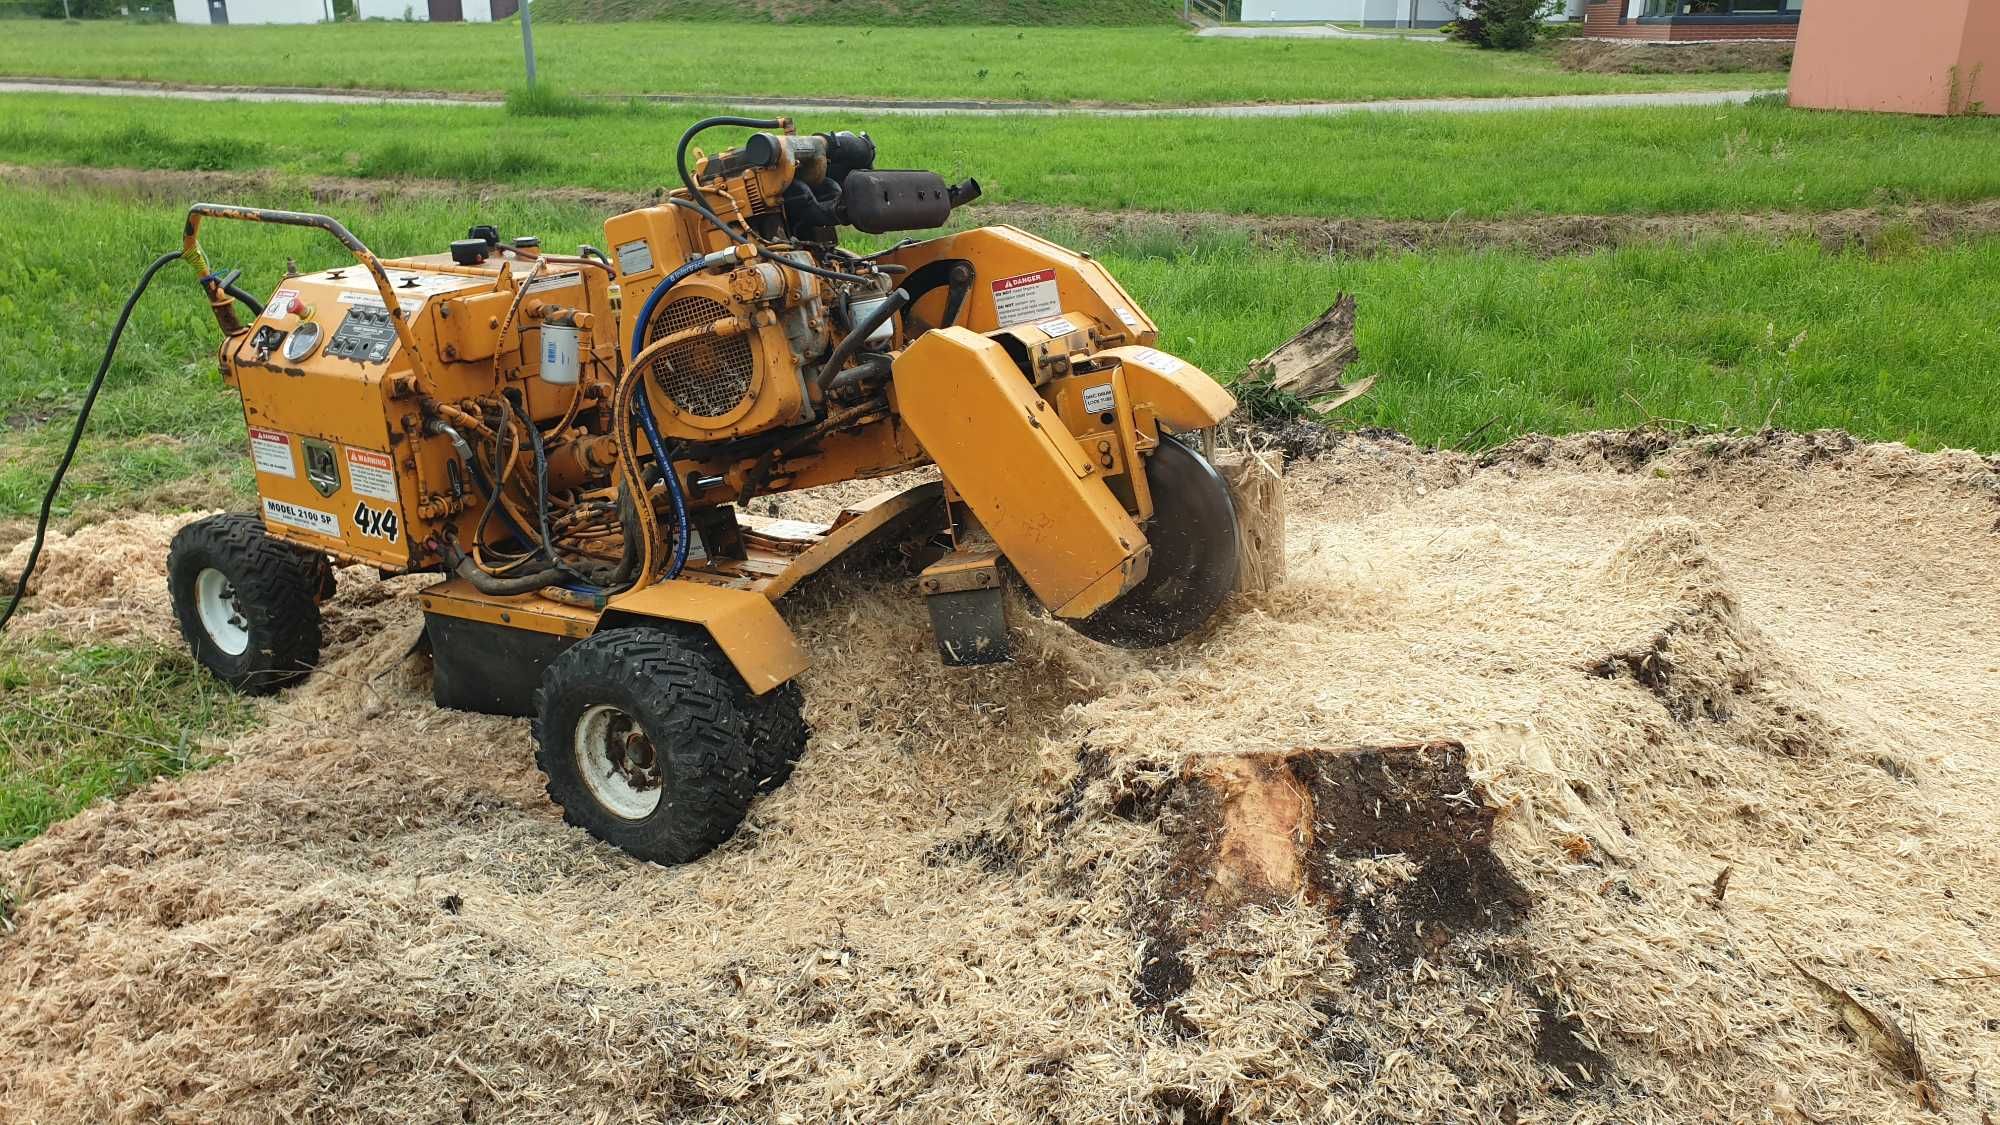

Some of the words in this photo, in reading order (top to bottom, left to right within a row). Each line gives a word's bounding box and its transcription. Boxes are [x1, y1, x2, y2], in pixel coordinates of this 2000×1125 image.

[1013, 274, 1041, 286] DANGER
[357, 453, 387, 467] WARNING
[268, 501, 296, 516] MODEL
[298, 509, 318, 521] 2100
[320, 513, 332, 525] SP
